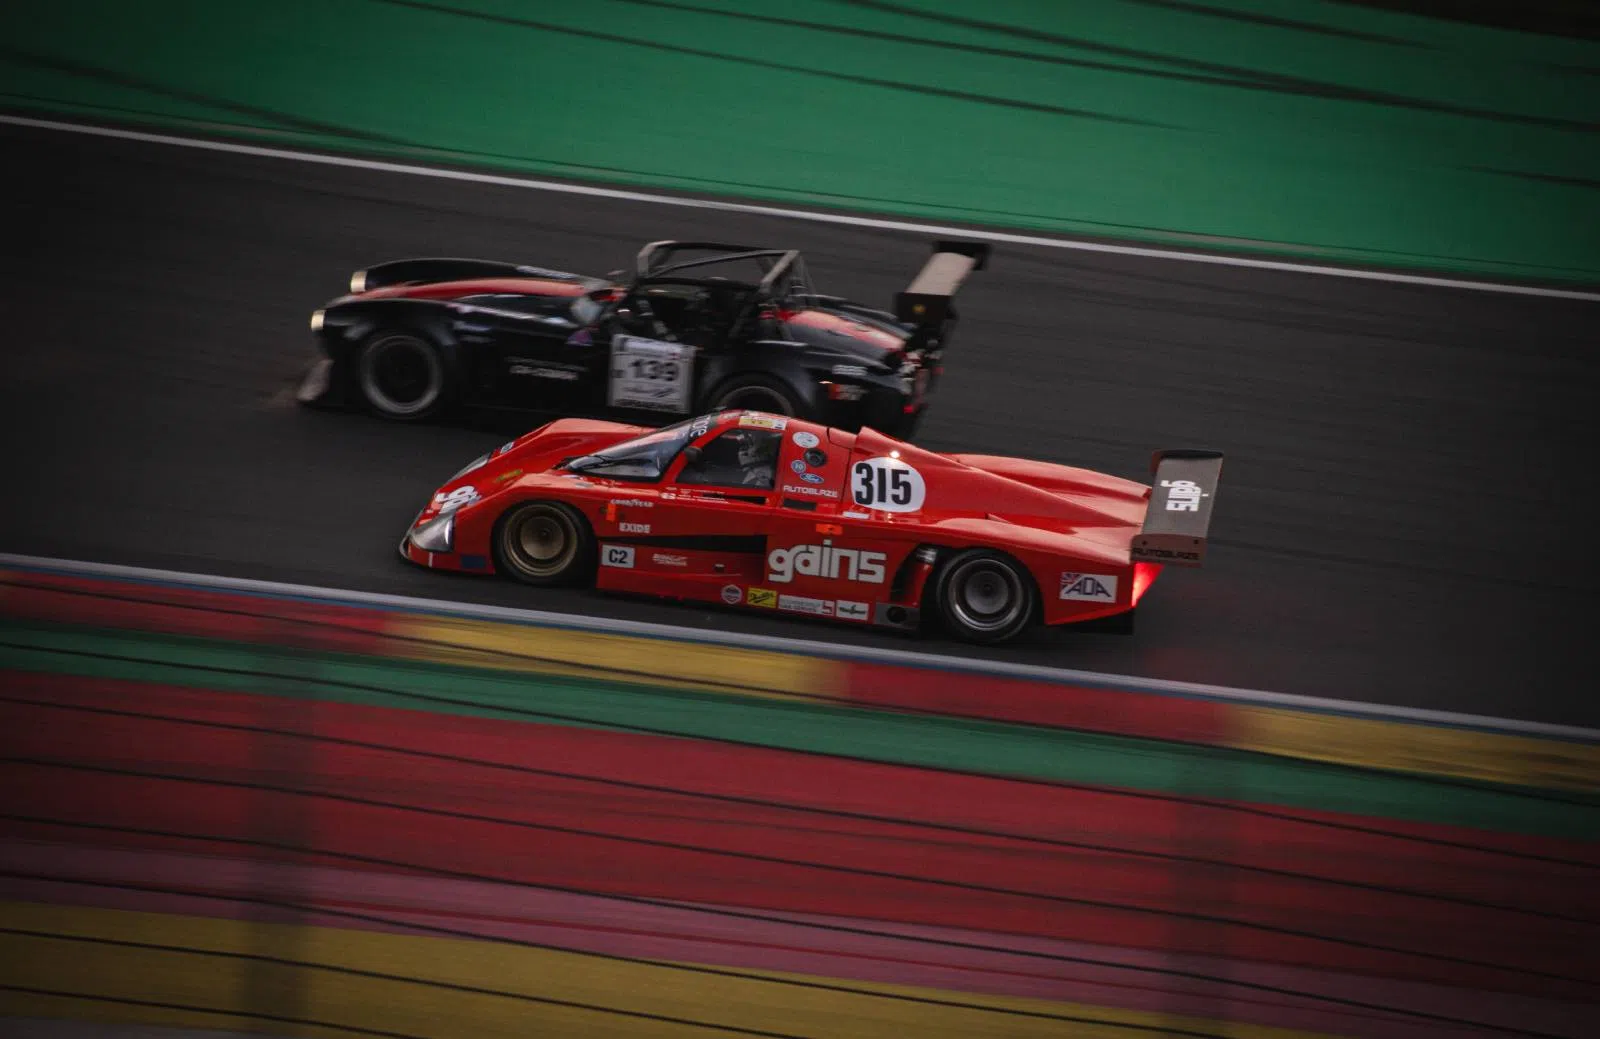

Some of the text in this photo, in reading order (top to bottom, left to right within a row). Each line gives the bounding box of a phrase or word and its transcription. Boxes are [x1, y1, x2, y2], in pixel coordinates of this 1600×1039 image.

[855, 463, 911, 505] 315
[1160, 480, 1209, 512] gains
[619, 522, 651, 533] EXIDE
[608, 548, 628, 564] C2
[768, 539, 887, 583] gains
[1065, 577, 1112, 598] ADA
